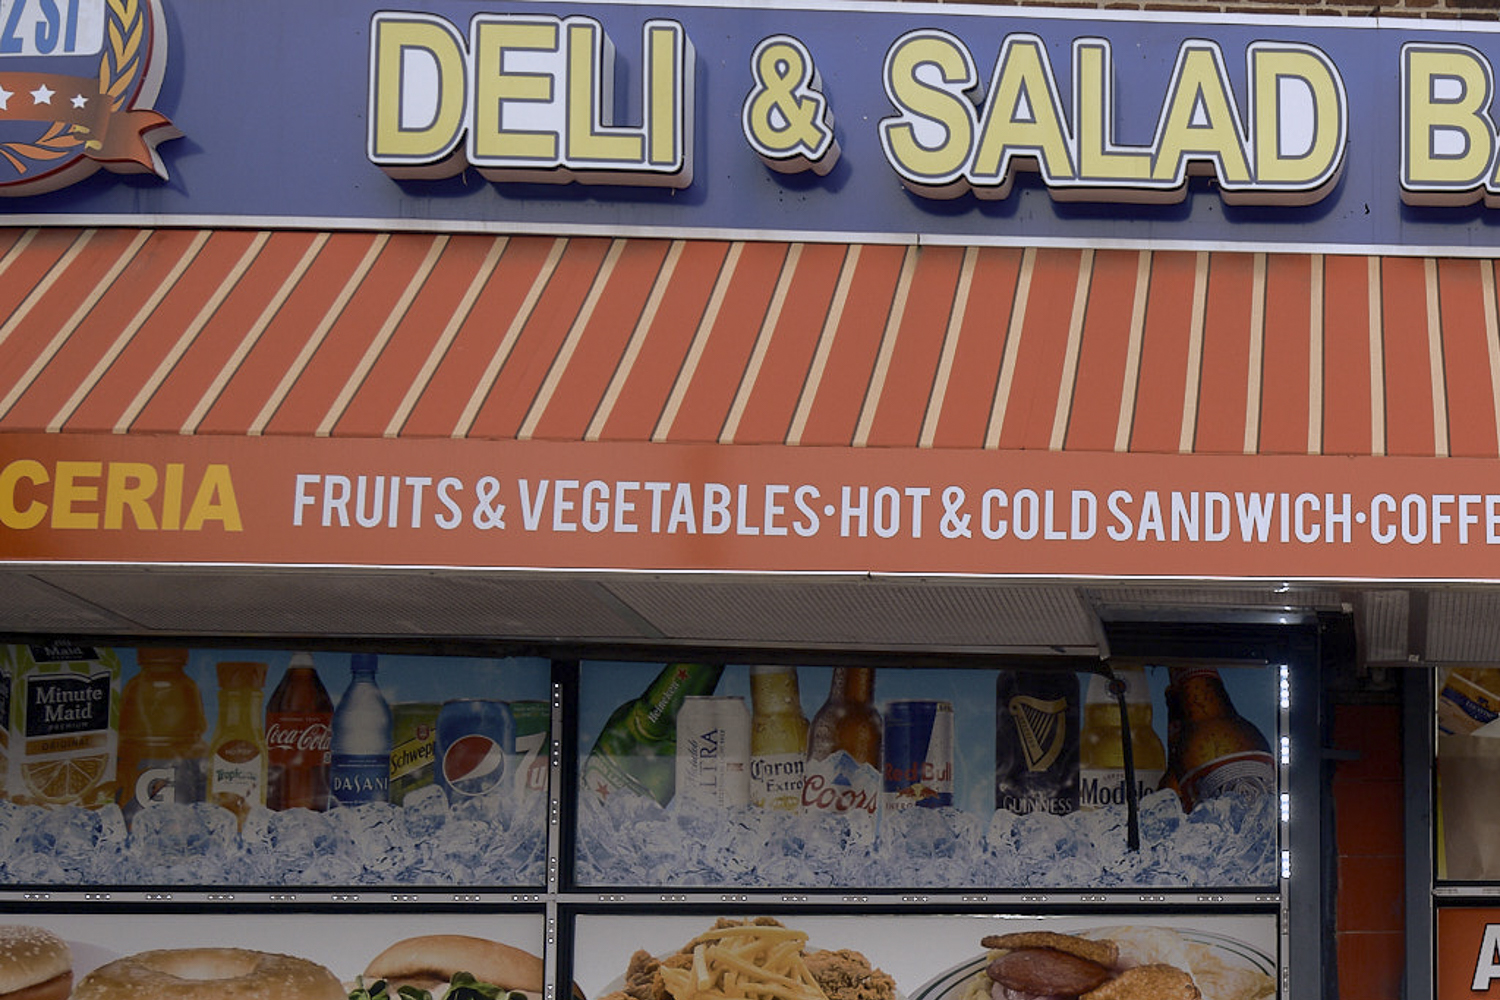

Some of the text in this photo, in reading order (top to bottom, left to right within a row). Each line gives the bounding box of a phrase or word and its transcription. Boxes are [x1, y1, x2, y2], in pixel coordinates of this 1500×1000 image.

[368, 11, 688, 172] DELI
[743, 35, 836, 165] &
[879, 29, 1348, 190] SALAD
[0, 460, 243, 531] CERIA
[293, 474, 464, 529] FRUITS
[474, 475, 505, 530] &
[940, 490, 972, 540] &
[981, 488, 1098, 541] COLD
[1108, 490, 1351, 544] SANDWICH
[36, 686, 103, 705] Minute
[45, 702, 93, 722] Maid
[390, 742, 436, 774] Schwep
[884, 762, 952, 782] Red Bull
[334, 774, 389, 793] DASANI
[802, 774, 878, 814] Coors
[1082, 778, 1154, 805] Modlo
